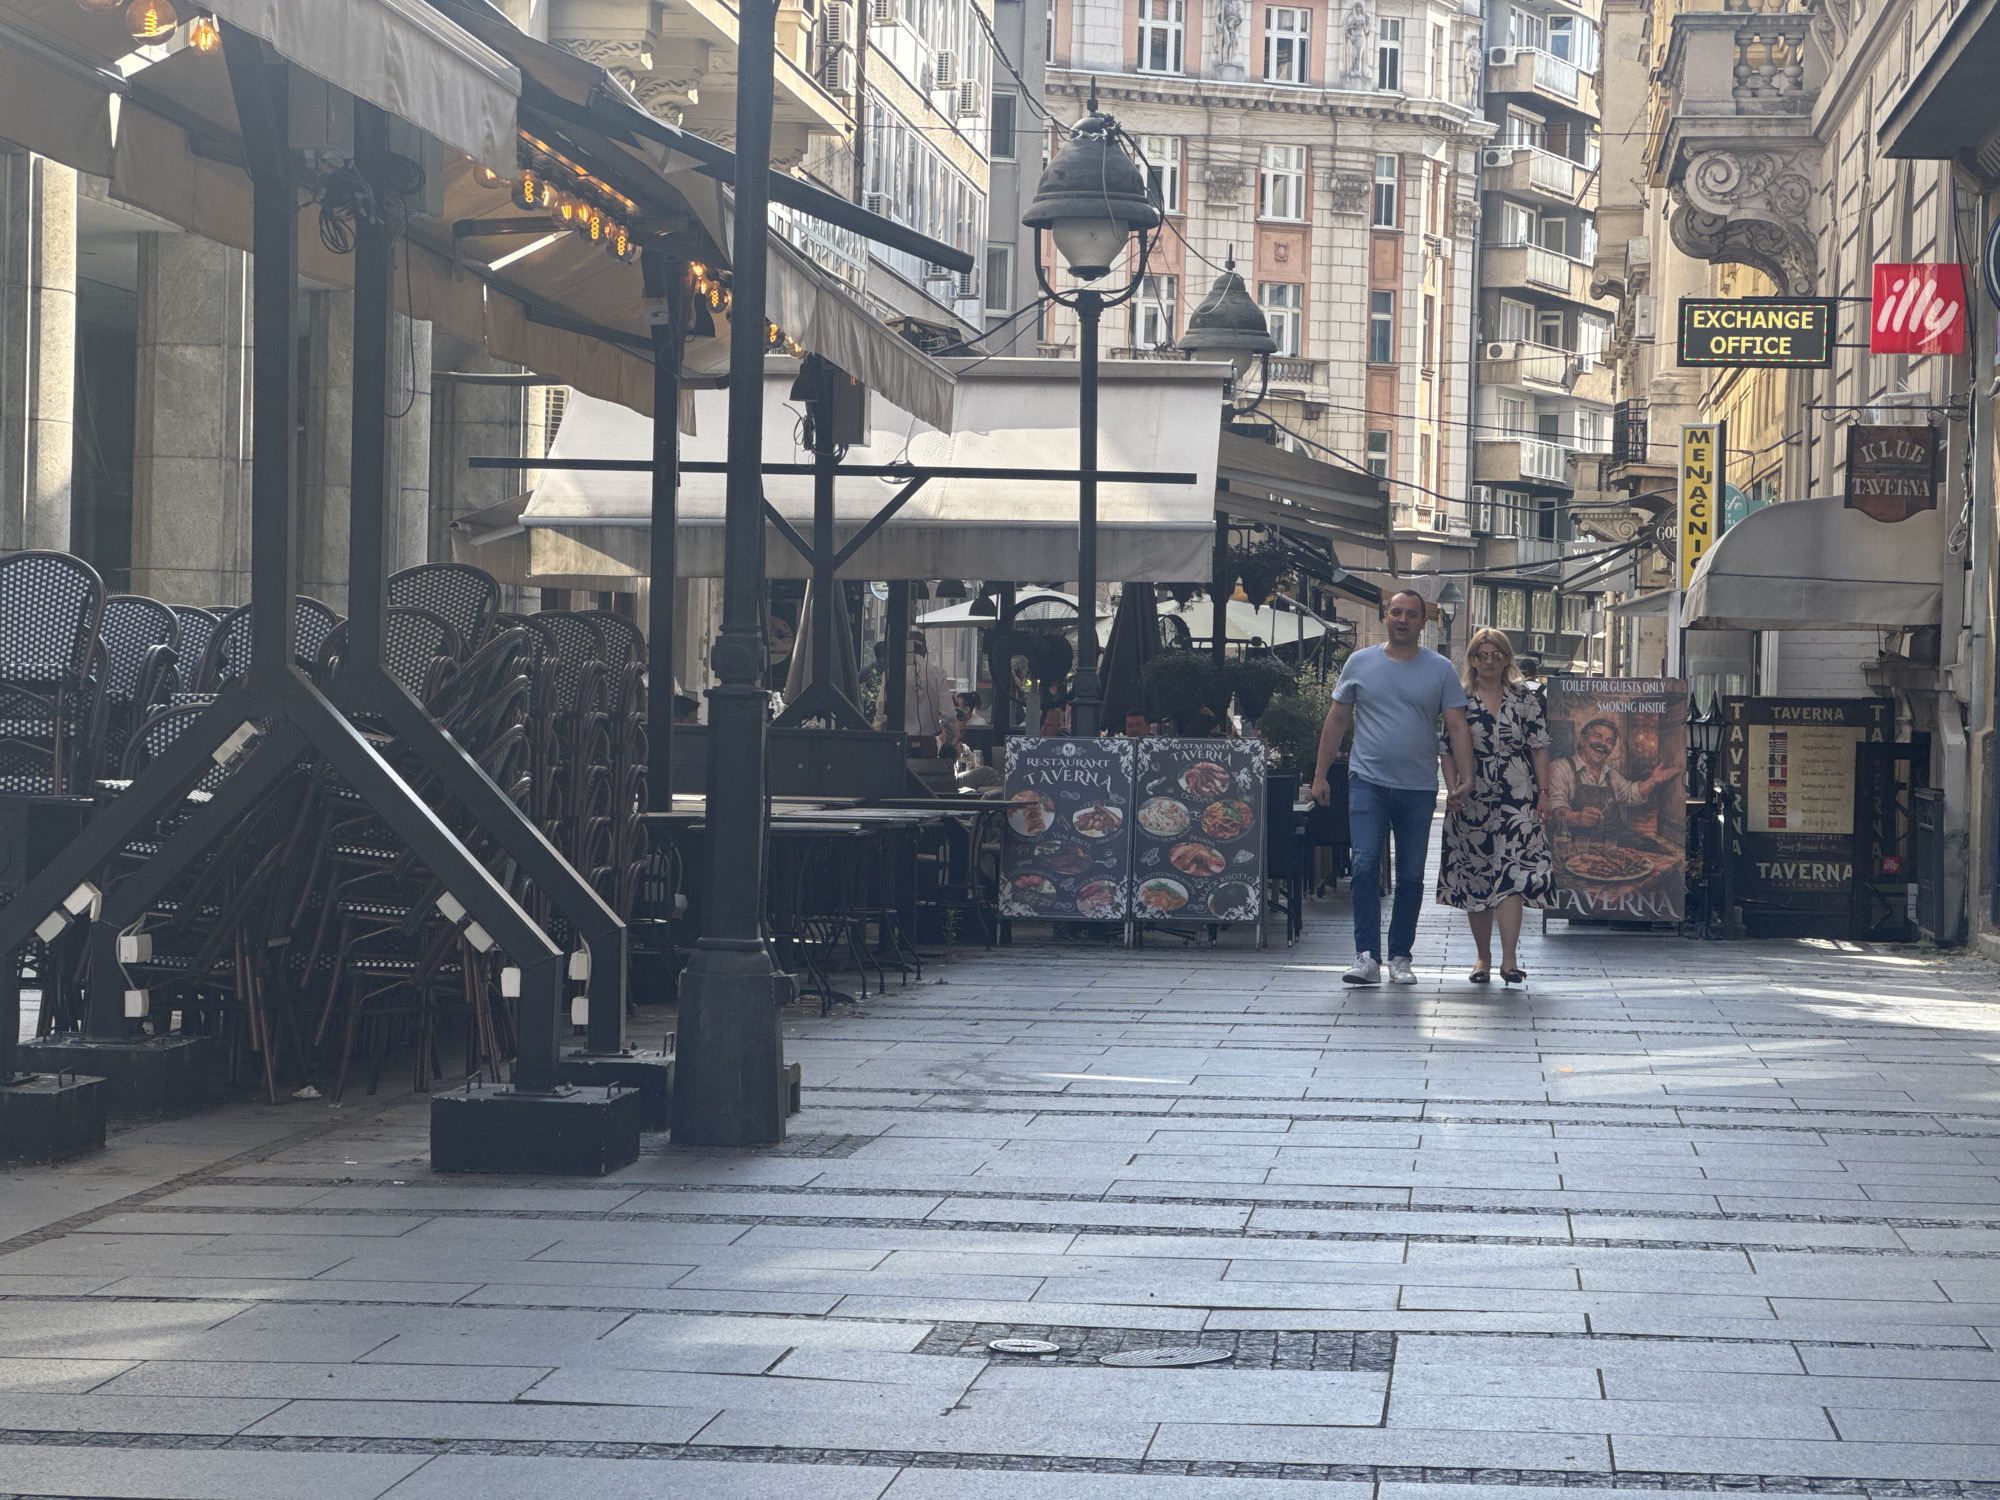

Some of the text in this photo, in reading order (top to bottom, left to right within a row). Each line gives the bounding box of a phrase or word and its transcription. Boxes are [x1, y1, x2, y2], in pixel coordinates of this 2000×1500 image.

[1693, 310, 1814, 329] EXCHANGE
[1877, 277, 1959, 346] illy
[1710, 336, 1791, 355] OFFICE
[1860, 439, 1925, 463] KLUB
[1852, 477, 1930, 497] TAVERNA
[1560, 679, 1666, 694] TOILET FOR GUESTS ONLY
[1597, 701, 1666, 714] SMOKING INSIDE
[1771, 706, 1845, 722] TAVERNA
[1172, 743, 1230, 751] RESTAURANT
[1026, 757, 1110, 769] RESTAURANT
[1170, 749, 1232, 767] TAVERNA
[1022, 767, 1112, 794] TAVERNA
[1181, 792, 1215, 804] OCTOPUS
[1052, 832, 1092, 850] VEAL RIBEYE
[1189, 834, 1216, 848] PRAWNS
[1756, 862, 1853, 882] TAVERNA
[1882, 859, 1899, 872] illy
[1198, 872, 1254, 902] BLACK RISOTTO
[1554, 885, 1681, 919] TAVERNA
